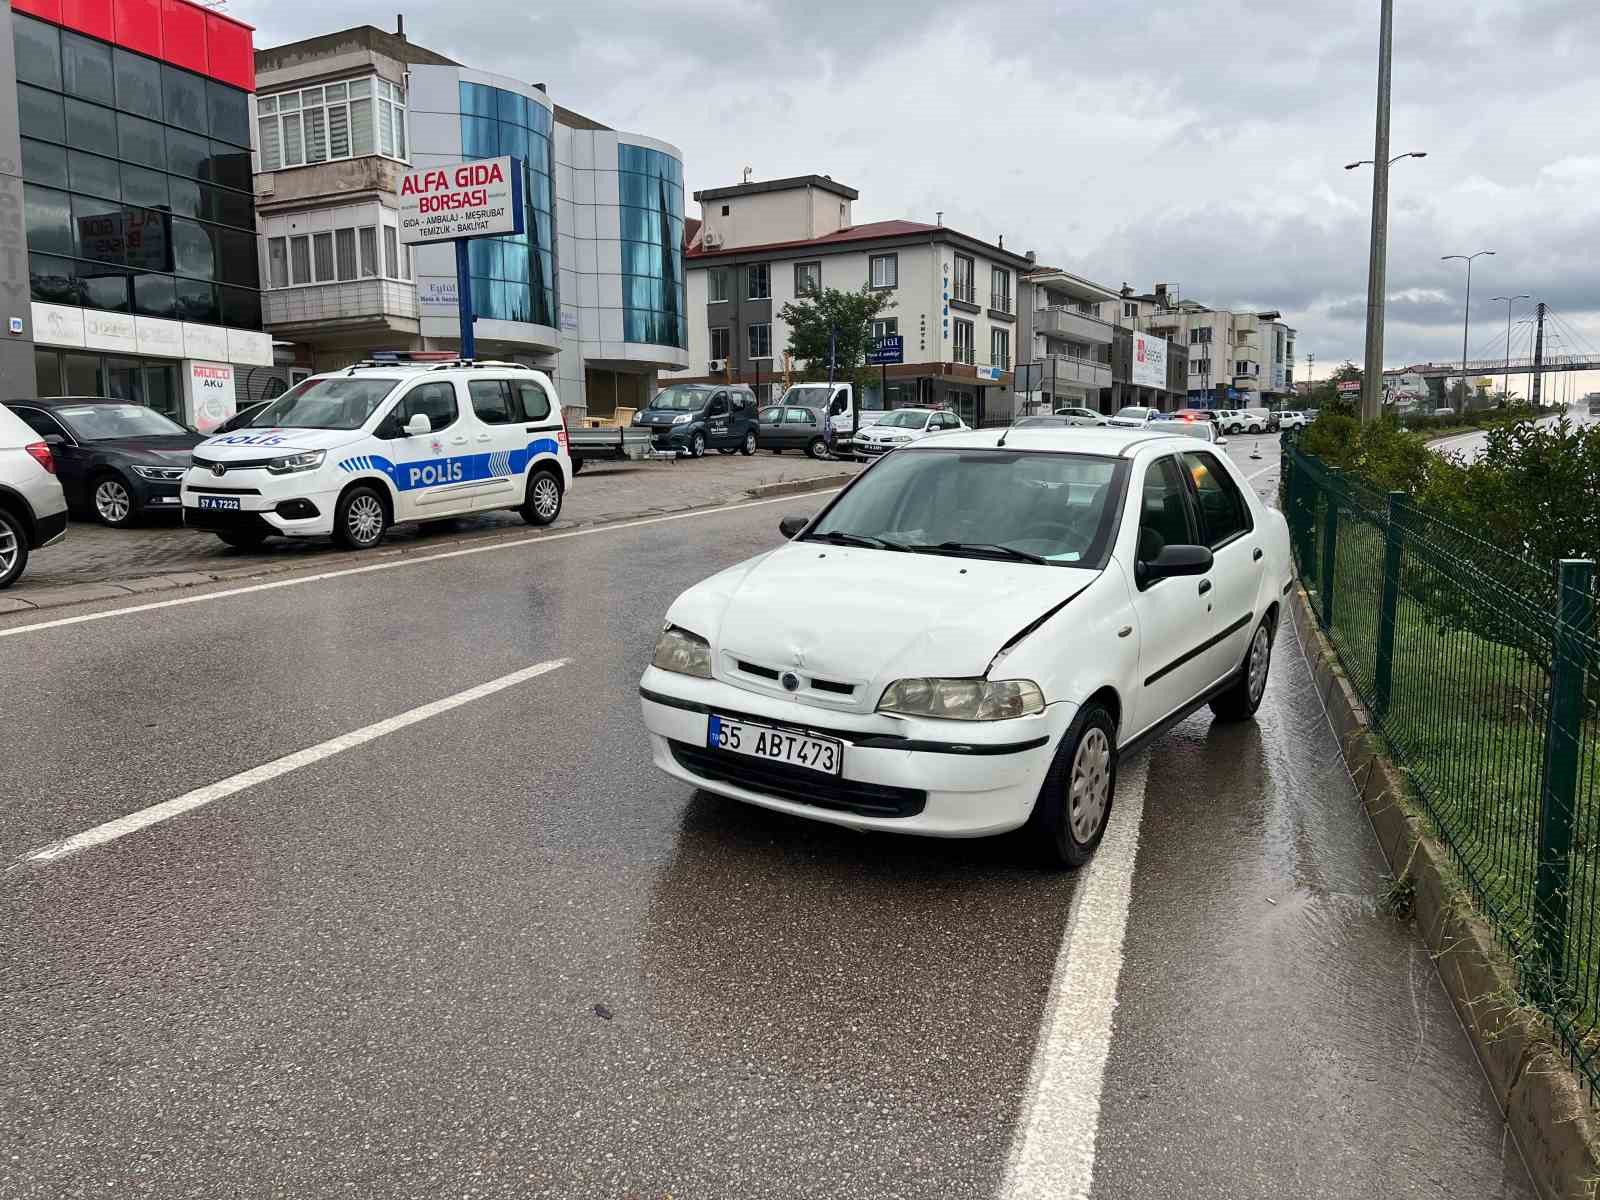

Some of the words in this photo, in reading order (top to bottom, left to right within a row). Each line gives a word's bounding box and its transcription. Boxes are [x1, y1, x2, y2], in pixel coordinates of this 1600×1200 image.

[401, 170, 448, 196] ALFA
[455, 163, 504, 188] GIDA
[419, 189, 487, 213] BORSASI
[403, 218, 420, 228] GIDA
[409, 459, 463, 486] POLİS
[199, 499, 209, 508] 57
[211, 500, 217, 508] A
[219, 500, 239, 510] 7222
[720, 723, 743, 749] 55
